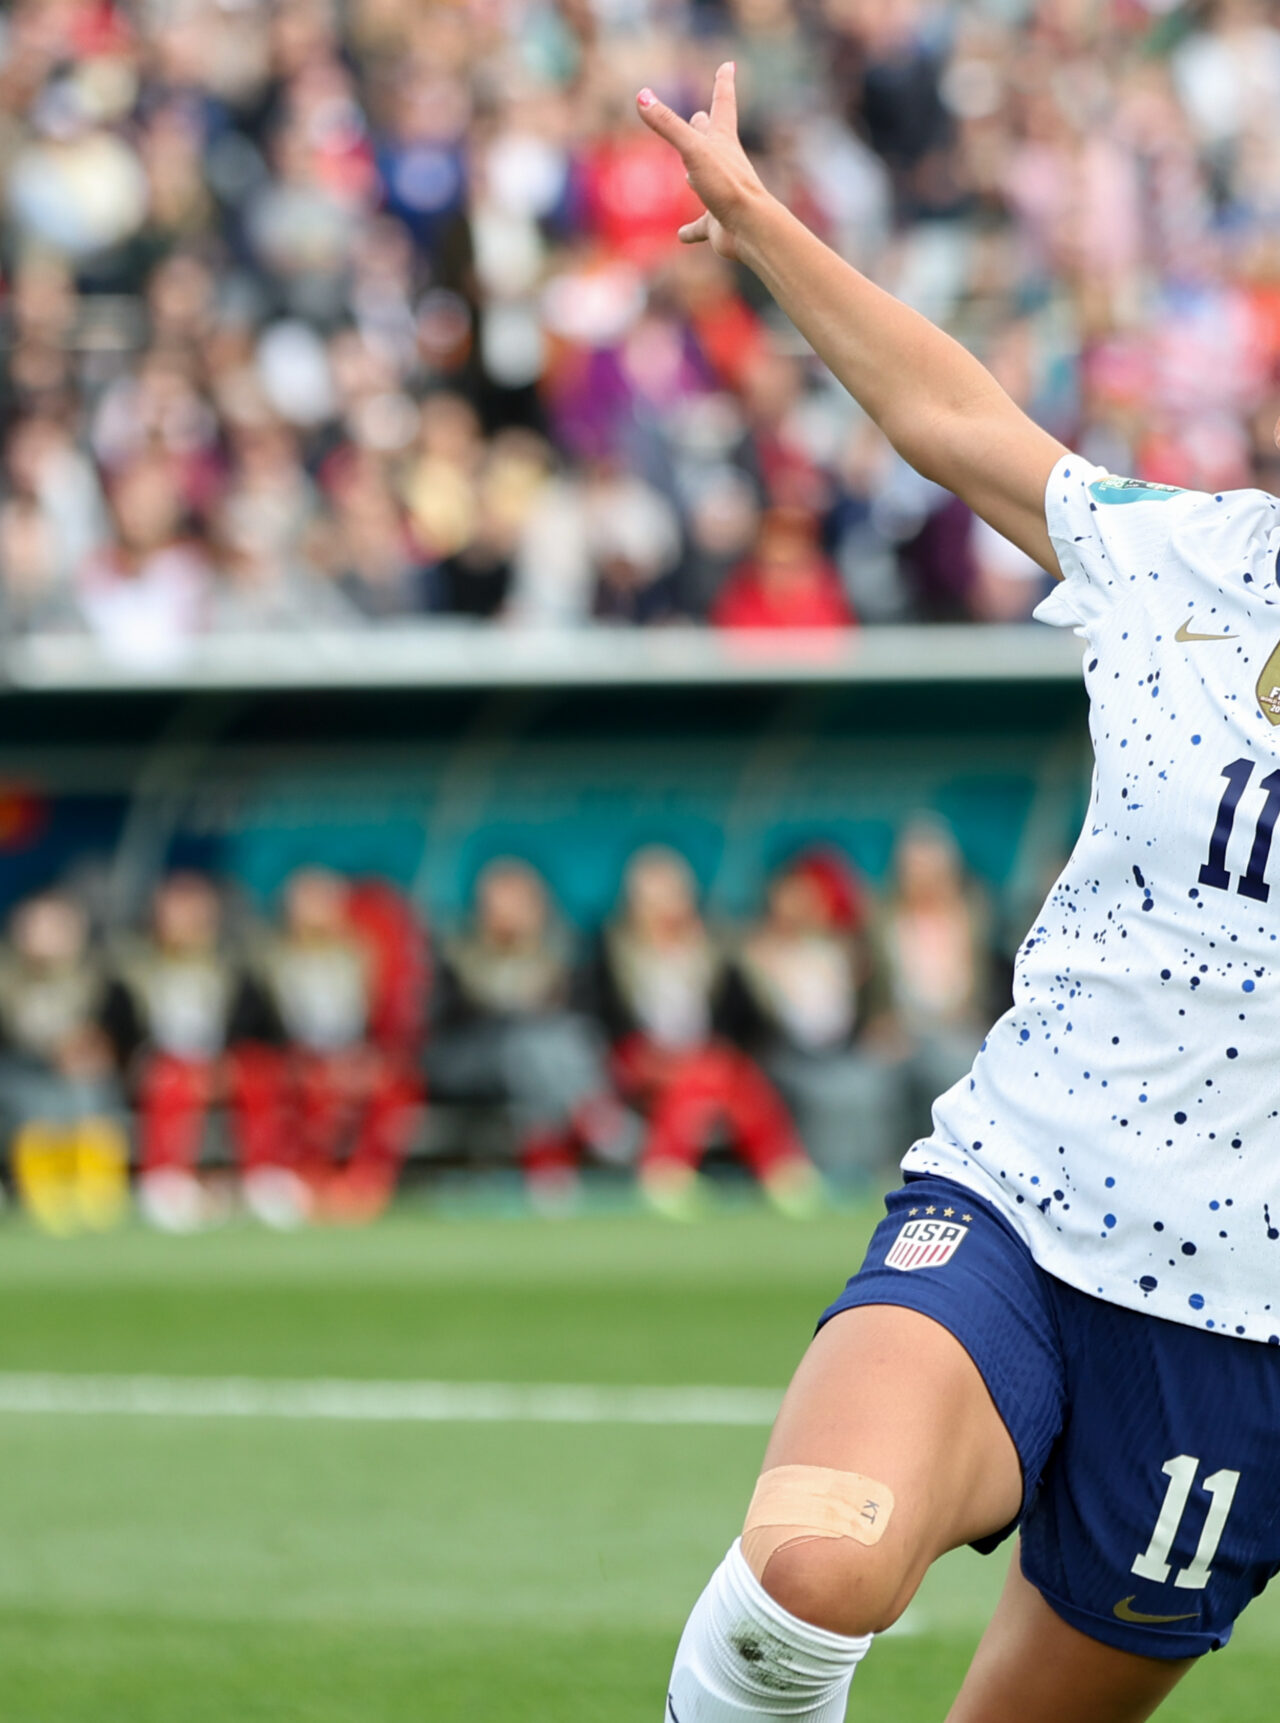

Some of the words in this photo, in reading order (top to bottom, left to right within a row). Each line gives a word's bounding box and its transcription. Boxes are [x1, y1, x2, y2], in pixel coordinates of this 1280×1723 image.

[903, 1223, 960, 1242] USA
[861, 1500, 880, 1525] KT
[1131, 1454, 1241, 1589] 11
